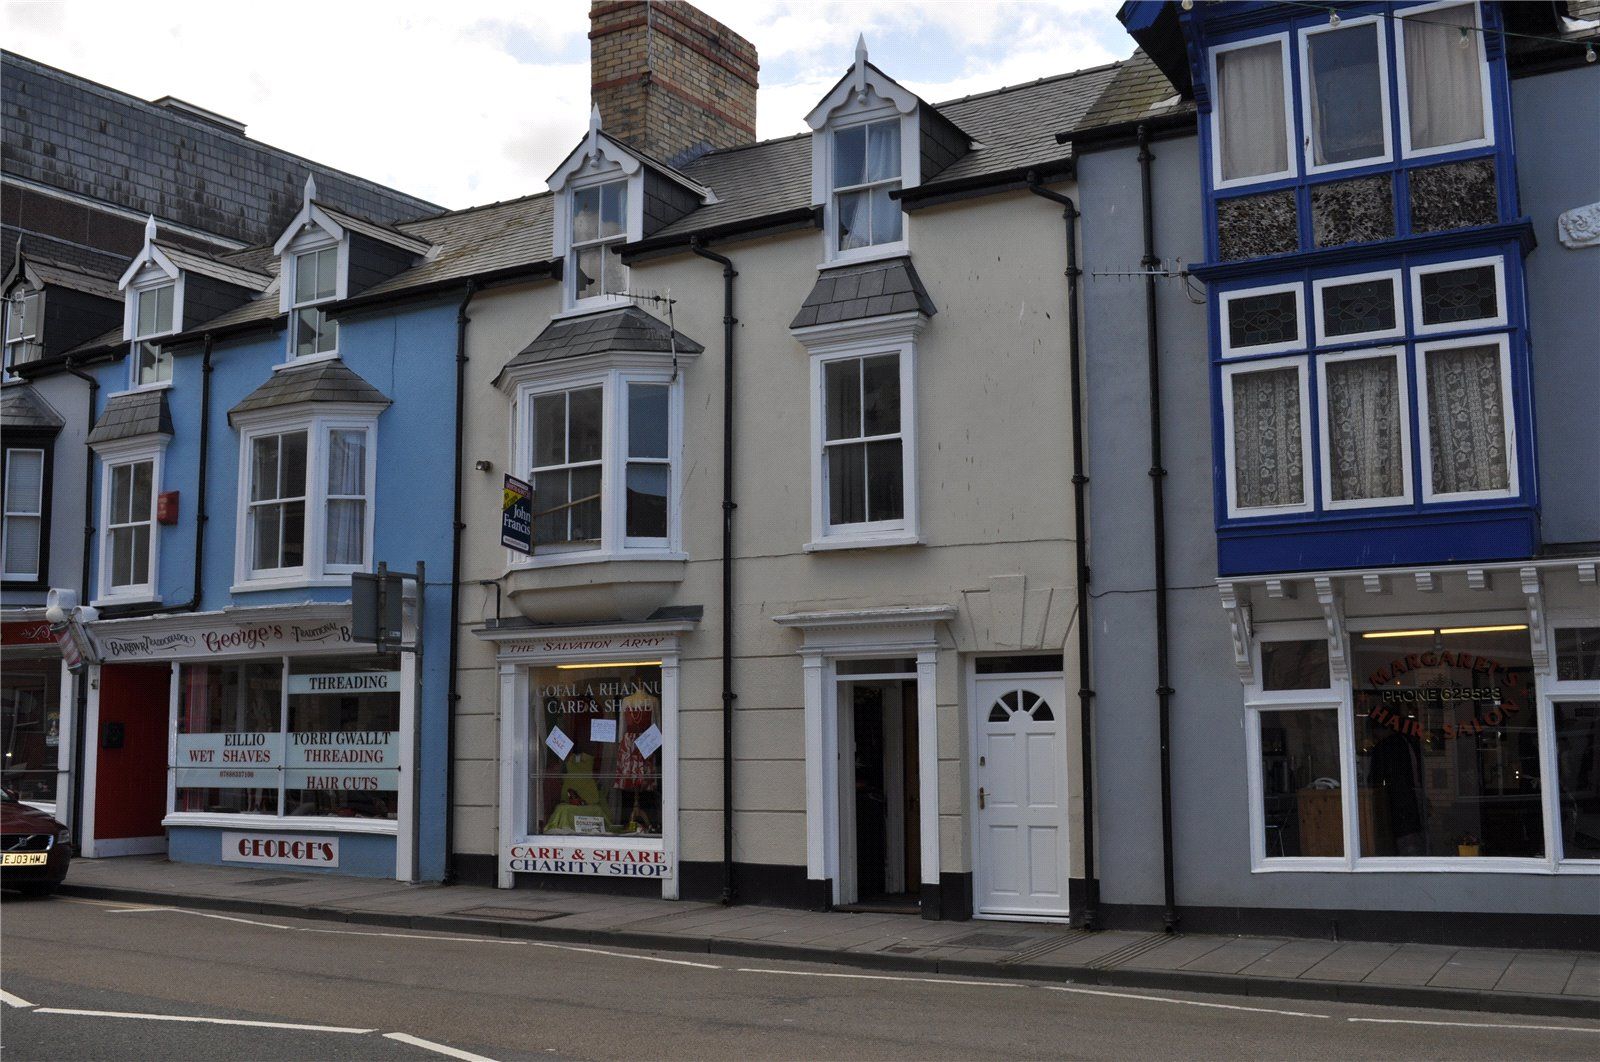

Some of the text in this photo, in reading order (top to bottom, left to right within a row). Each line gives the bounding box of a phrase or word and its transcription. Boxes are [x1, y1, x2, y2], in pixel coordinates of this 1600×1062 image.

[514, 504, 531, 522] John
[504, 513, 531, 535] Francis
[202, 624, 283, 653] George's
[510, 637, 665, 653] THE SALVATION ARMY
[309, 675, 388, 690] THREADING
[585, 683, 594, 696] A
[1382, 689, 1438, 703] PHONE
[547, 700, 585, 714] CARE
[589, 699, 599, 713] &
[1370, 705, 1426, 738] HAIR
[225, 734, 265, 747] EILLIO
[293, 732, 391, 745] TORRI GWALLT
[189, 749, 271, 762] WET SHAVES
[304, 749, 384, 762] THREADING
[307, 776, 378, 790] HAIR CUTS
[238, 838, 334, 861] GEORGE'S
[511, 847, 666, 864] CARE & SHARE
[510, 859, 668, 877] CHARITY SHOP
